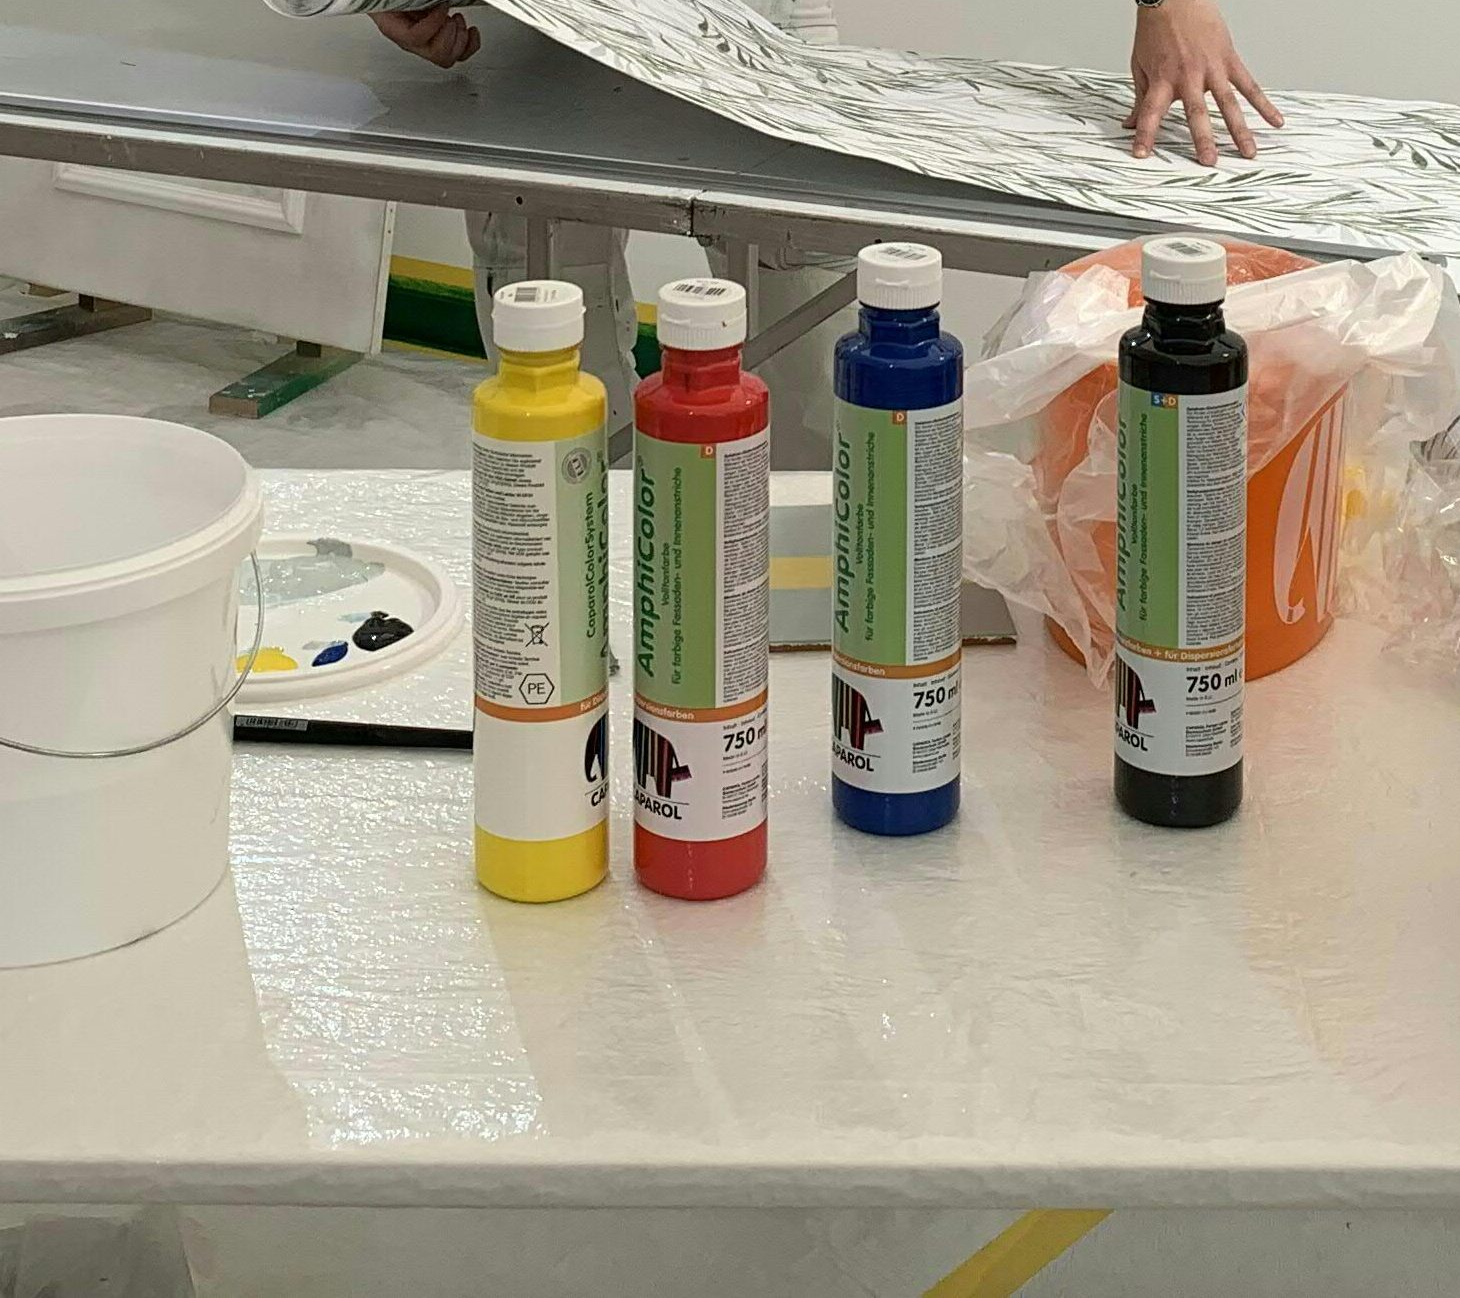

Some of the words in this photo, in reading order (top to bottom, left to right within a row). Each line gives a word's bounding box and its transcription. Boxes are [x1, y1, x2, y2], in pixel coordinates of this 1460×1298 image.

[866, 509, 874, 530] und
[585, 491, 596, 638] CaparolColorSystem
[672, 548, 681, 569] und
[865, 587, 876, 623] farbige
[672, 630, 684, 666] farbige
[527, 682, 546, 695] PE
[1186, 673, 1221, 693] 750
[1224, 669, 1237, 687] ml
[913, 687, 946, 709] 750
[723, 727, 755, 752] 750
